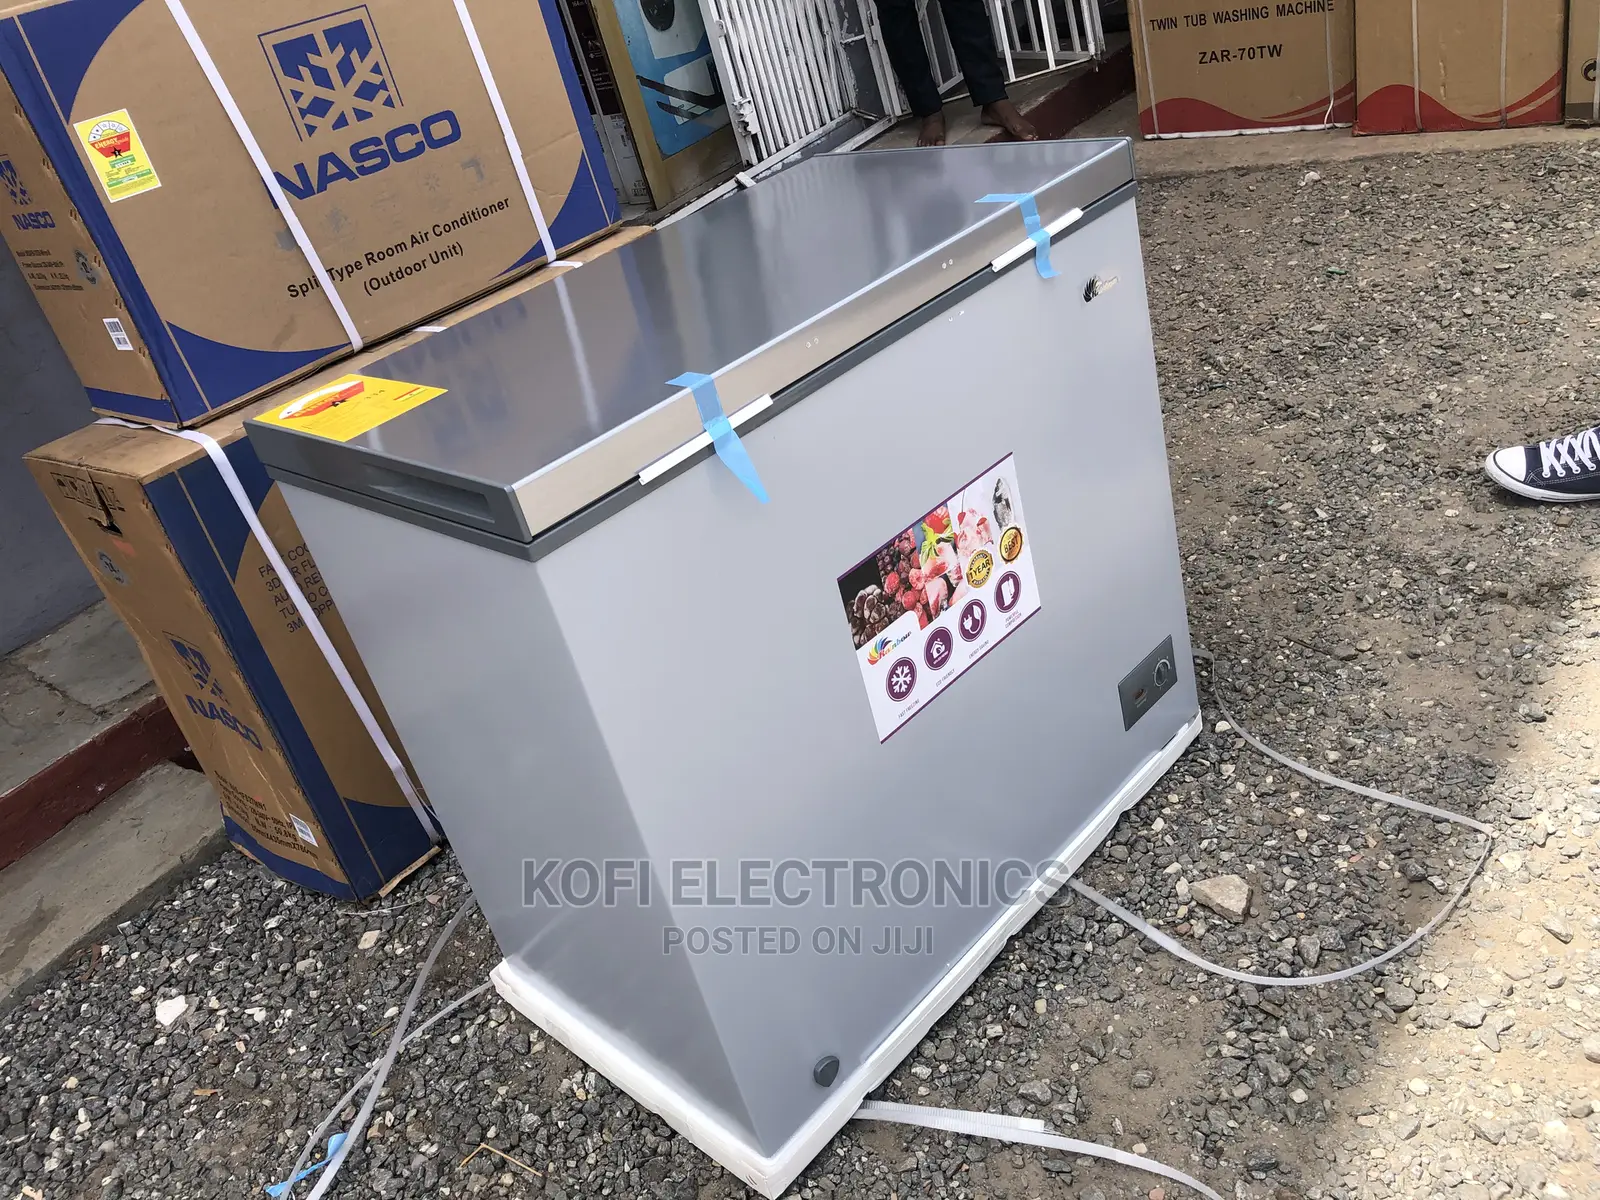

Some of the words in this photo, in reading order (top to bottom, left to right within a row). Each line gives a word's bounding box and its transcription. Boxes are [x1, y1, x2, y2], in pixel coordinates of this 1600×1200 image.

[1150, 17, 1178, 31] TWIN
[1184, 14, 1207, 27] TUB
[1213, 6, 1269, 24] WASHING
[1276, 0, 1334, 17] MACHINE
[1198, 44, 1283, 65] ZAR-70TW
[261, 110, 462, 209] NASCO
[12, 211, 56, 230] NASCO
[287, 275, 322, 299] Spli
[326, 258, 363, 282] Type
[364, 241, 407, 266] Room
[410, 230, 430, 249] Air
[432, 197, 511, 237] Conditioner
[363, 259, 428, 296] (Outdoor
[429, 241, 464, 265] Unit)
[1004, 534, 1019, 554] BEST
[973, 559, 991, 576] YEAR
[265, 577, 281, 592] 3D
[185, 694, 263, 751] NASCO
